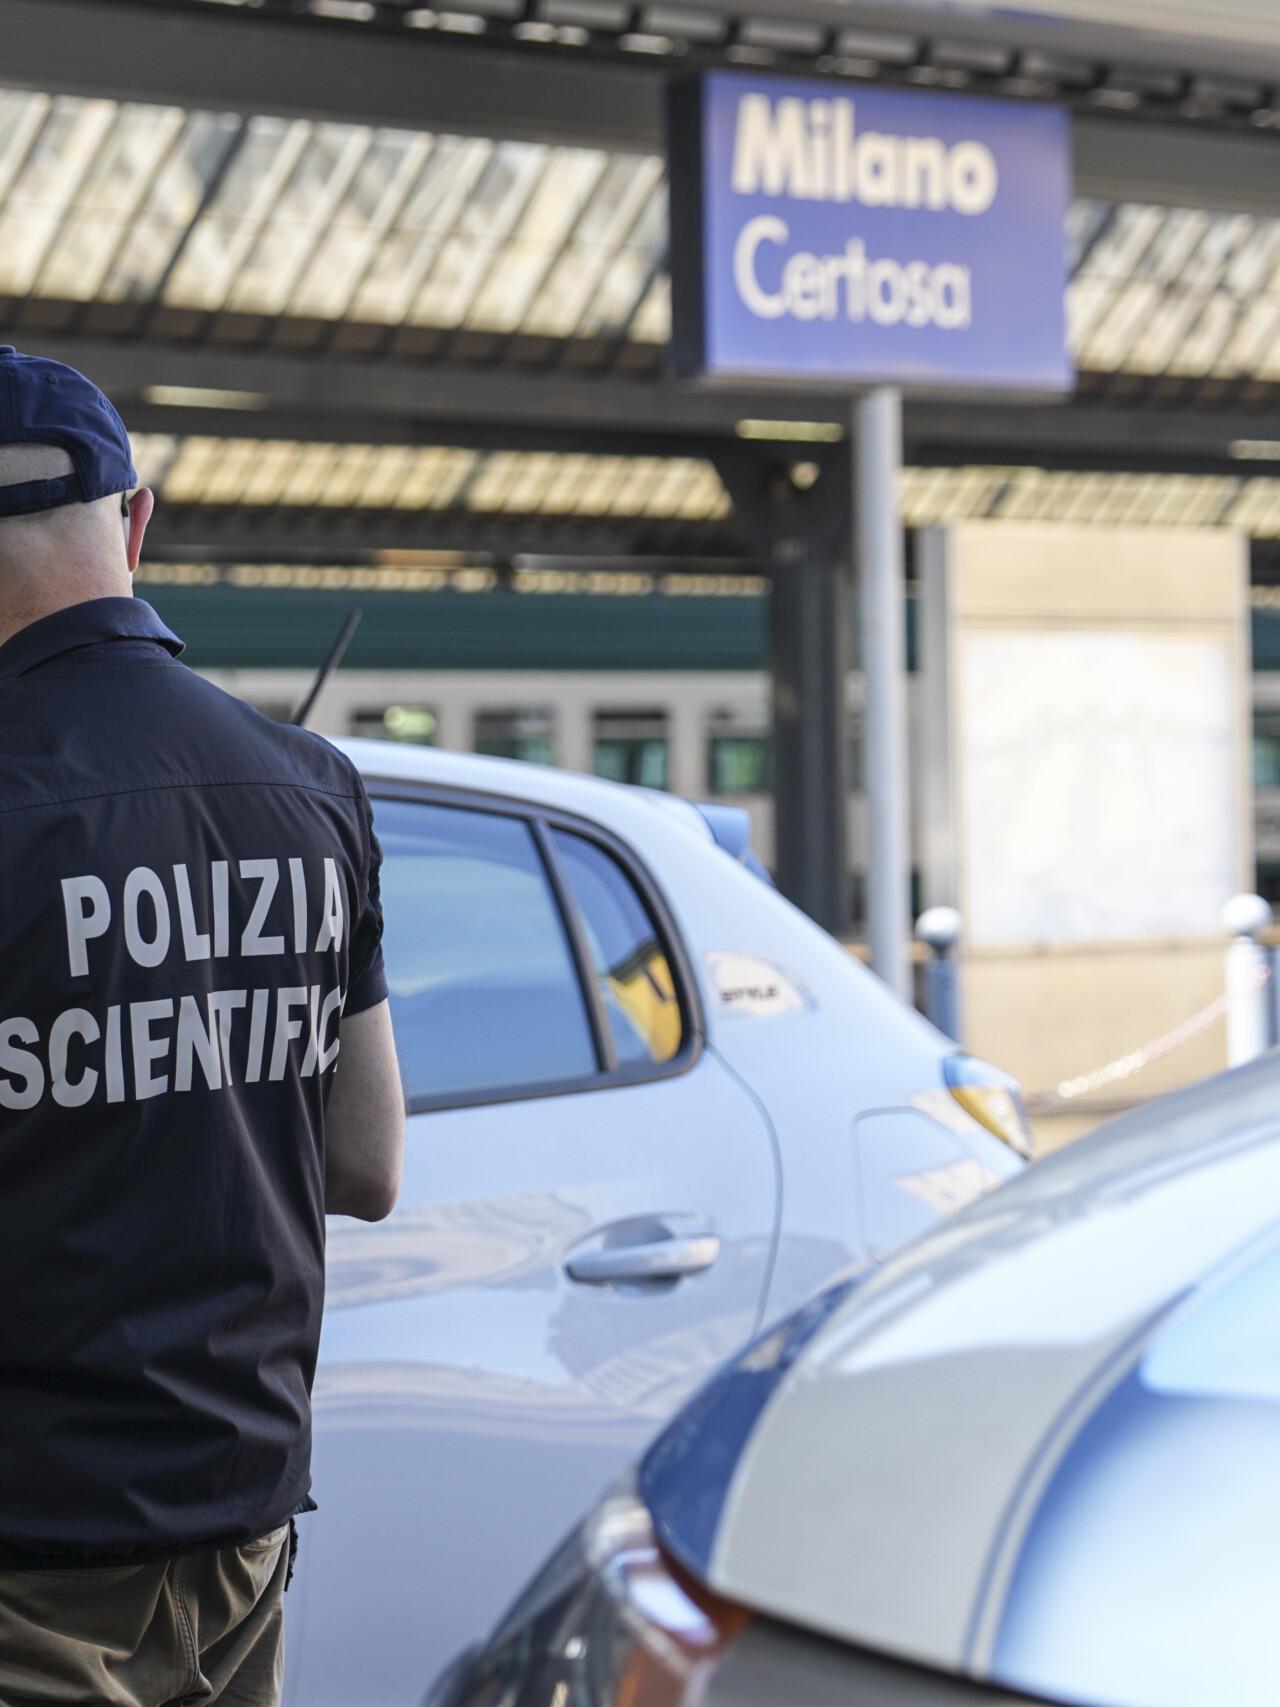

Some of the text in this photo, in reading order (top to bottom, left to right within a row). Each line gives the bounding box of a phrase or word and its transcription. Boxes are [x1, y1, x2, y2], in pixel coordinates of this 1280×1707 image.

[732, 92, 998, 216] Milano
[733, 214, 971, 330] Certosa
[61, 858, 344, 977] POLIZIA
